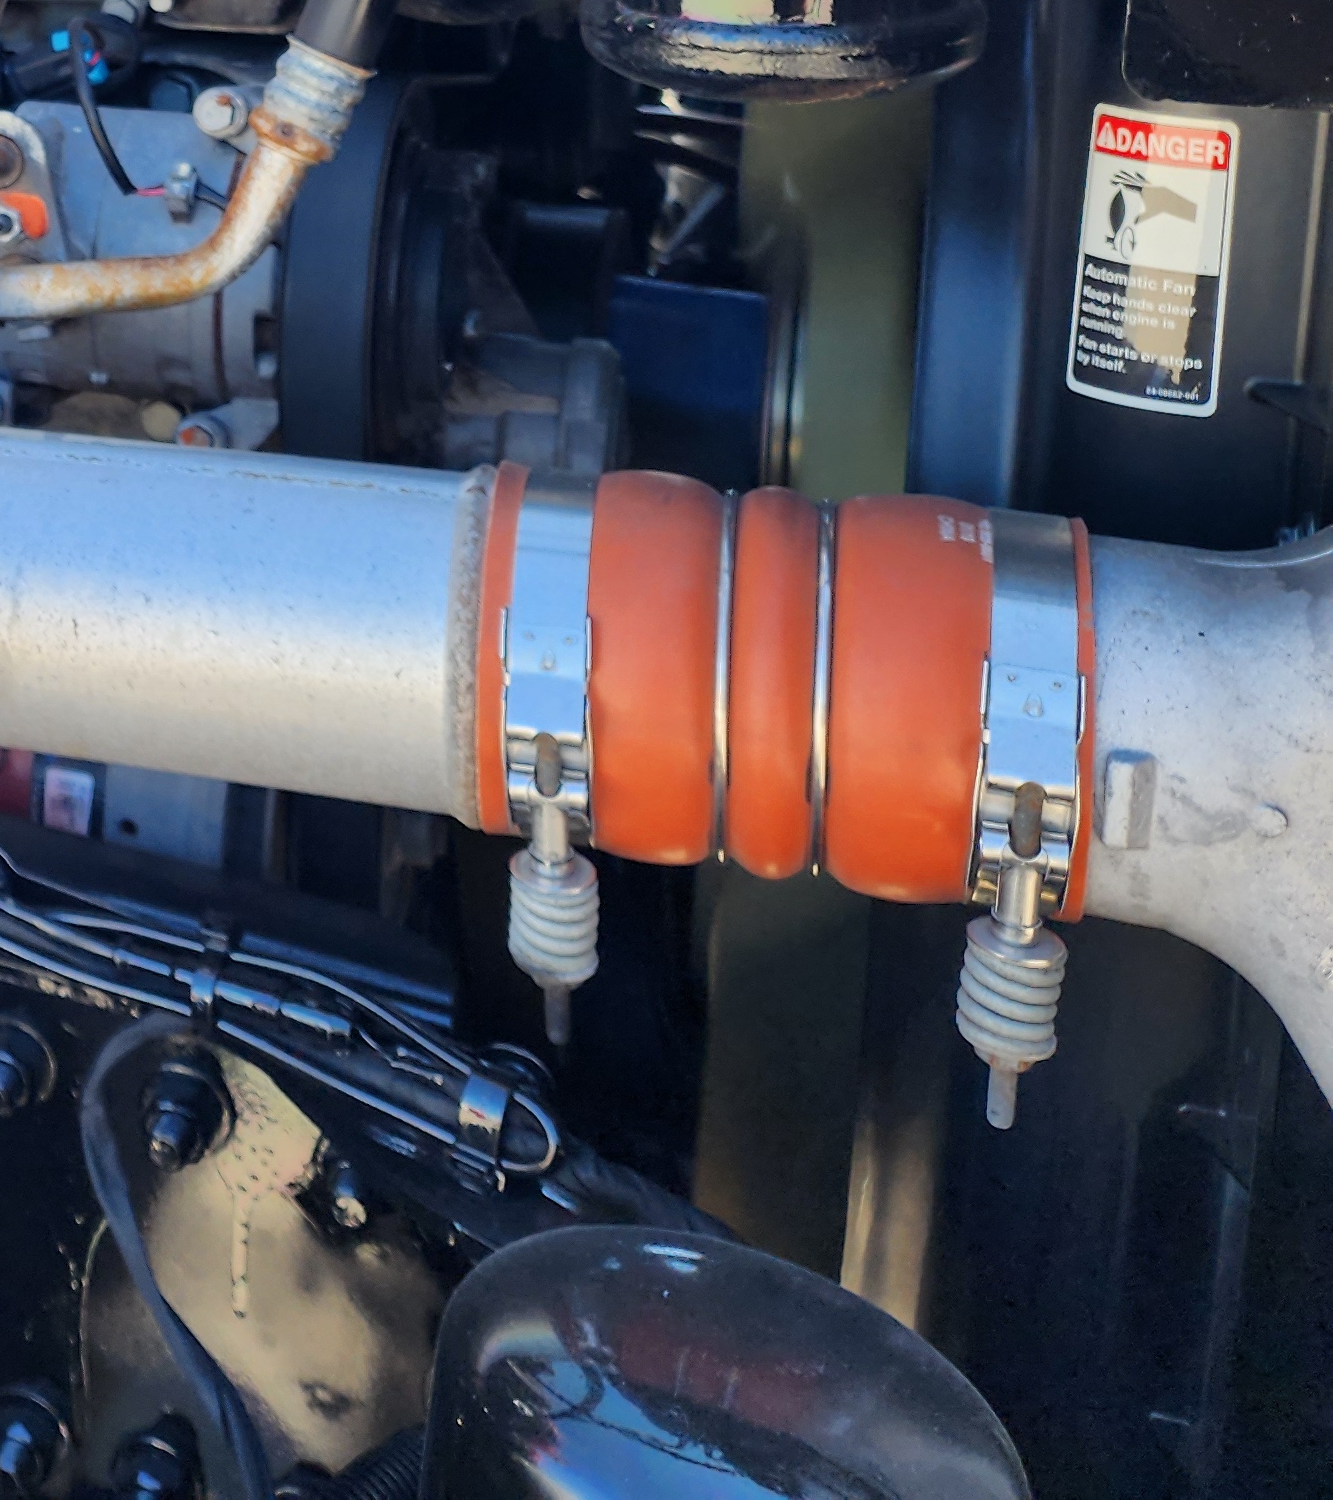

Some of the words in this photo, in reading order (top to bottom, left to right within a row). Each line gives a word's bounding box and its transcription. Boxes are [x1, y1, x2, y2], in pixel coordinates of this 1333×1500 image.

[1115, 126, 1227, 167] DANGER
[1085, 263, 1157, 292] Automatic
[1163, 280, 1196, 297] Fan
[1083, 285, 1111, 305] Keep
[1113, 292, 1153, 312] hands
[1158, 303, 1197, 318] clear
[1112, 309, 1158, 328] engine
[1163, 319, 1176, 331] is
[1077, 349, 1090, 367] by
[1078, 334, 1098, 352] Fan
[1099, 342, 1139, 361] starts
[1141, 351, 1157, 364] or
[1157, 356, 1203, 371] stops
